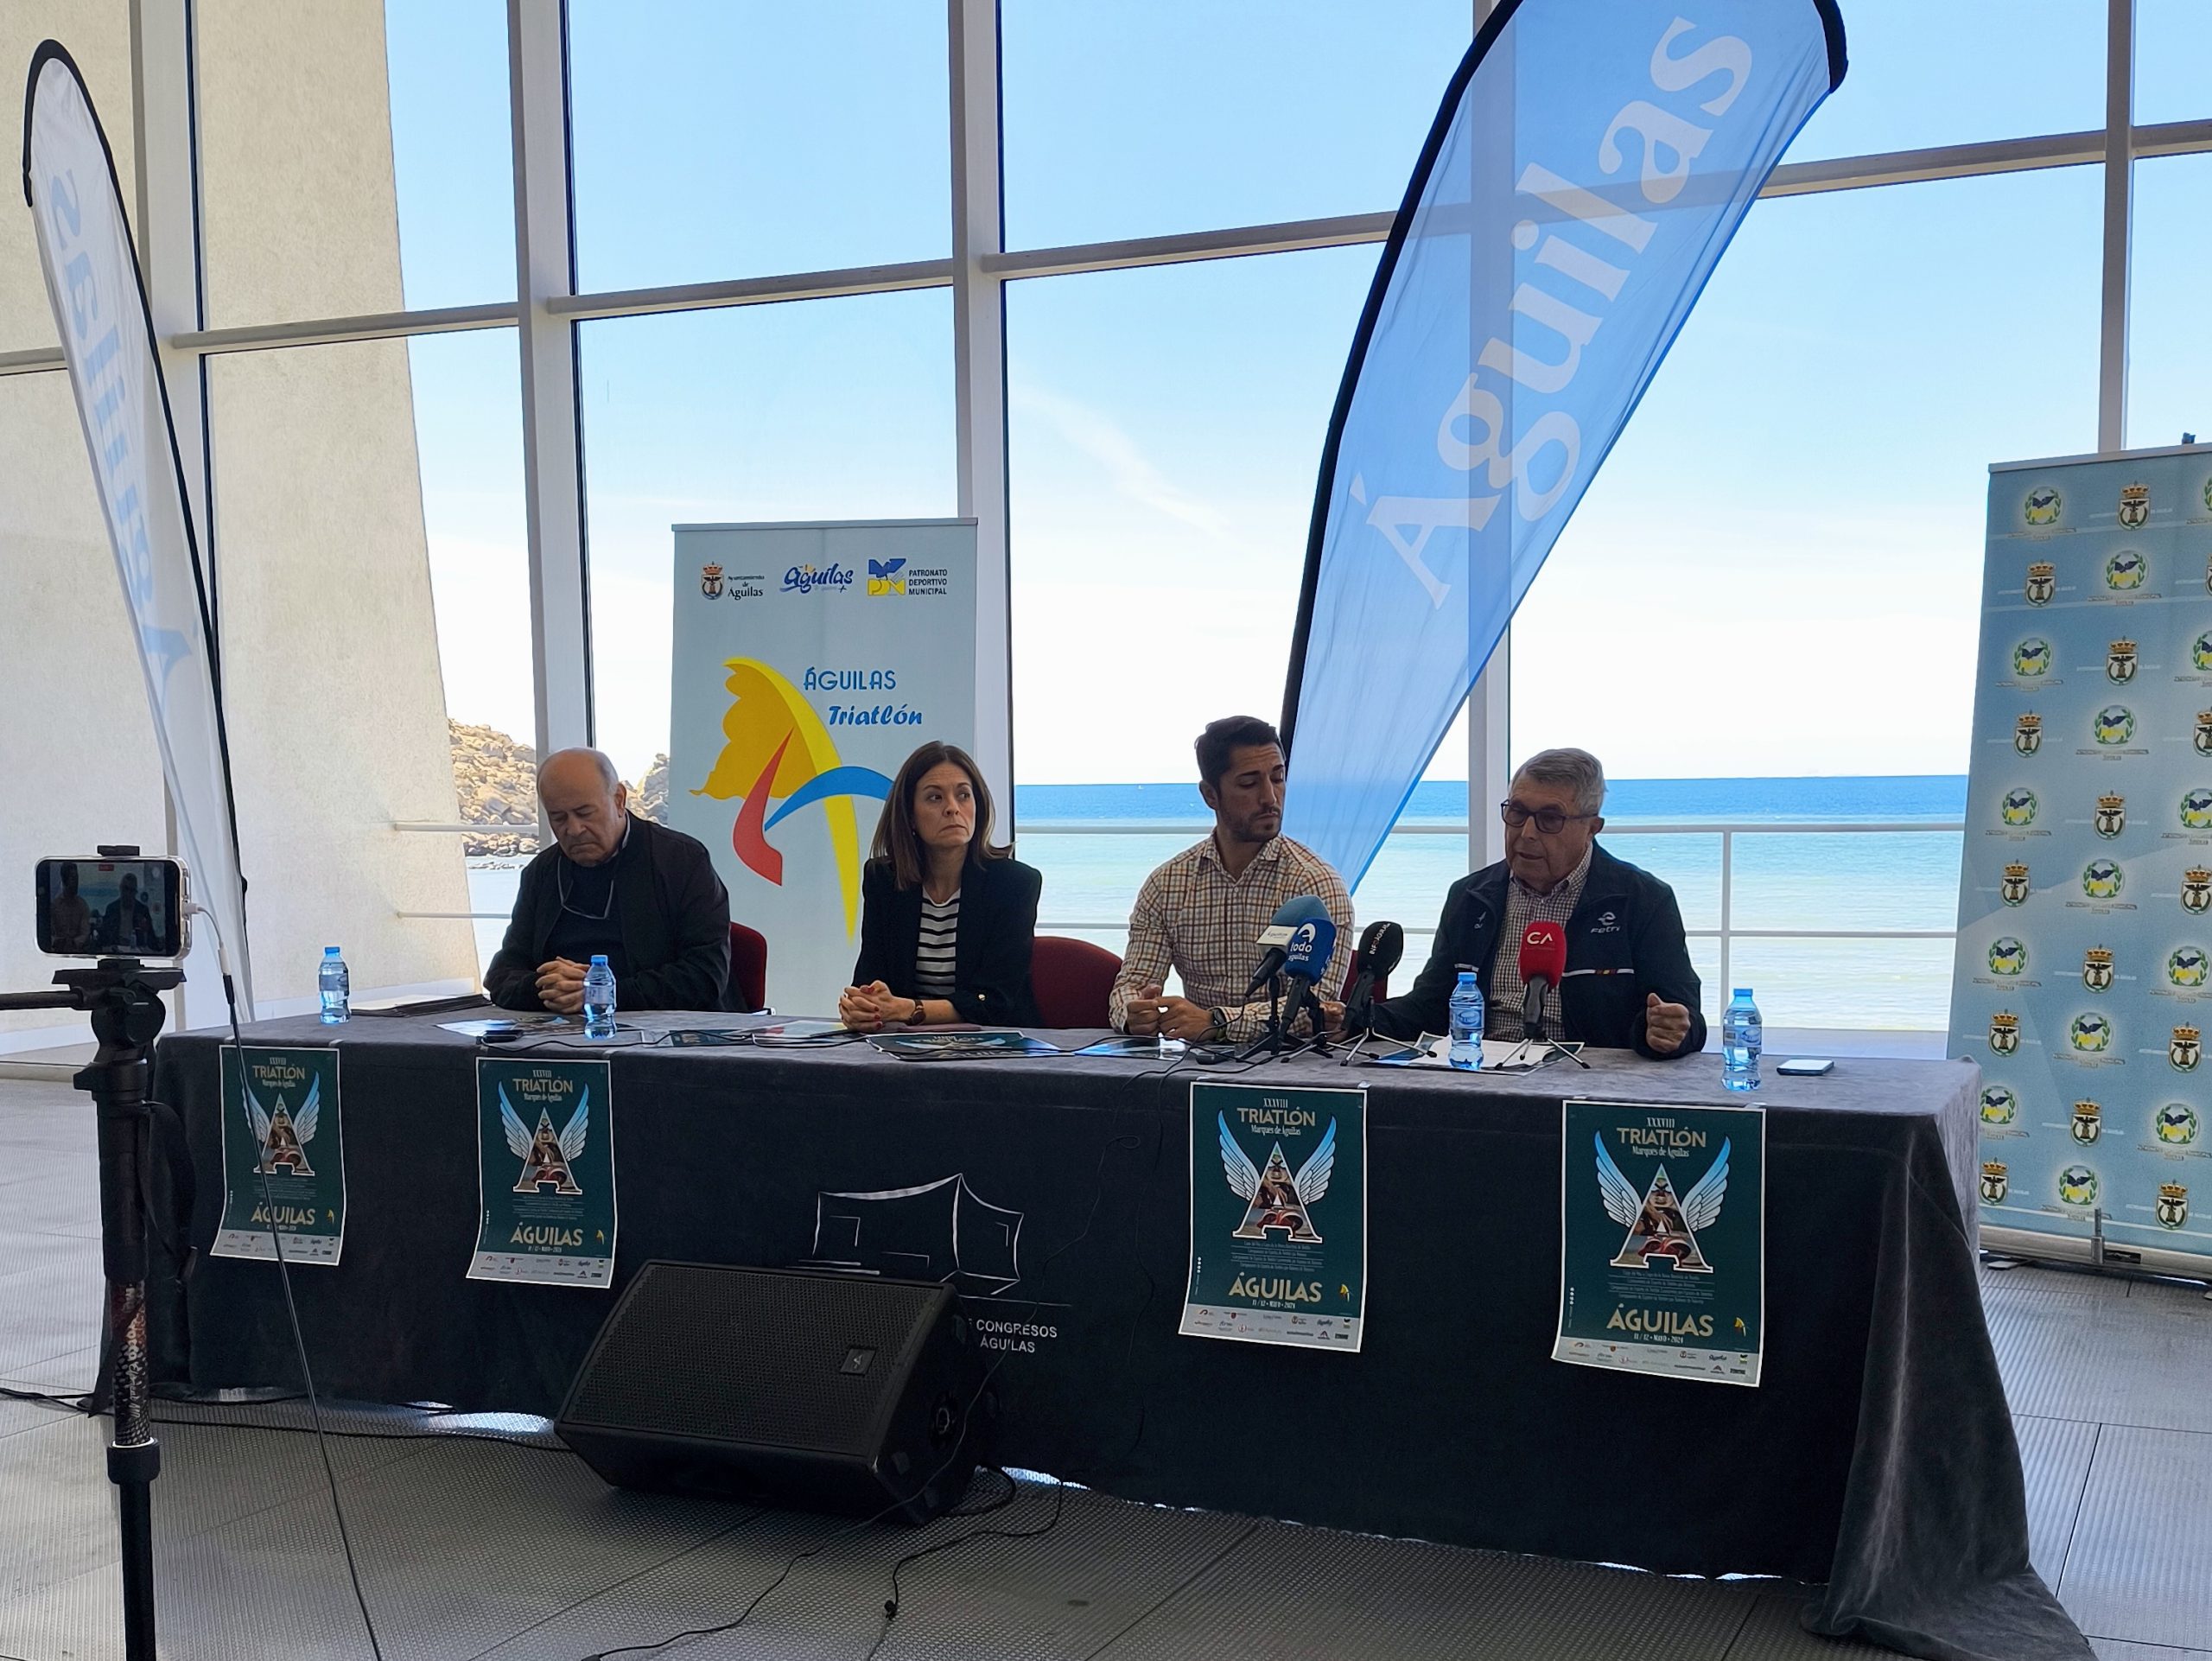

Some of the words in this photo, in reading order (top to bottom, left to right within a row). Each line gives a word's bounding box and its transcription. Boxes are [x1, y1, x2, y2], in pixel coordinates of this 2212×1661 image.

[1350, 16, 1752, 610] Águilas
[908, 569, 948, 577] PATRONATO
[804, 666, 897, 690] ÁGUILAS
[829, 703, 923, 725] Triatlón
[252, 1063, 306, 1080] TRIATLÓN
[512, 1075, 574, 1093] TRIATLÓN
[1236, 1106, 1316, 1127] TRIATLÓN
[1616, 1126, 1707, 1148] TRIATLÓN
[510, 1221, 584, 1246] ÁGUILAS
[1229, 1272, 1323, 1302] ÁGUILAS
[976, 1319, 1058, 1338] CONGRESOS
[1606, 1302, 1714, 1337] ÁGUILAS
